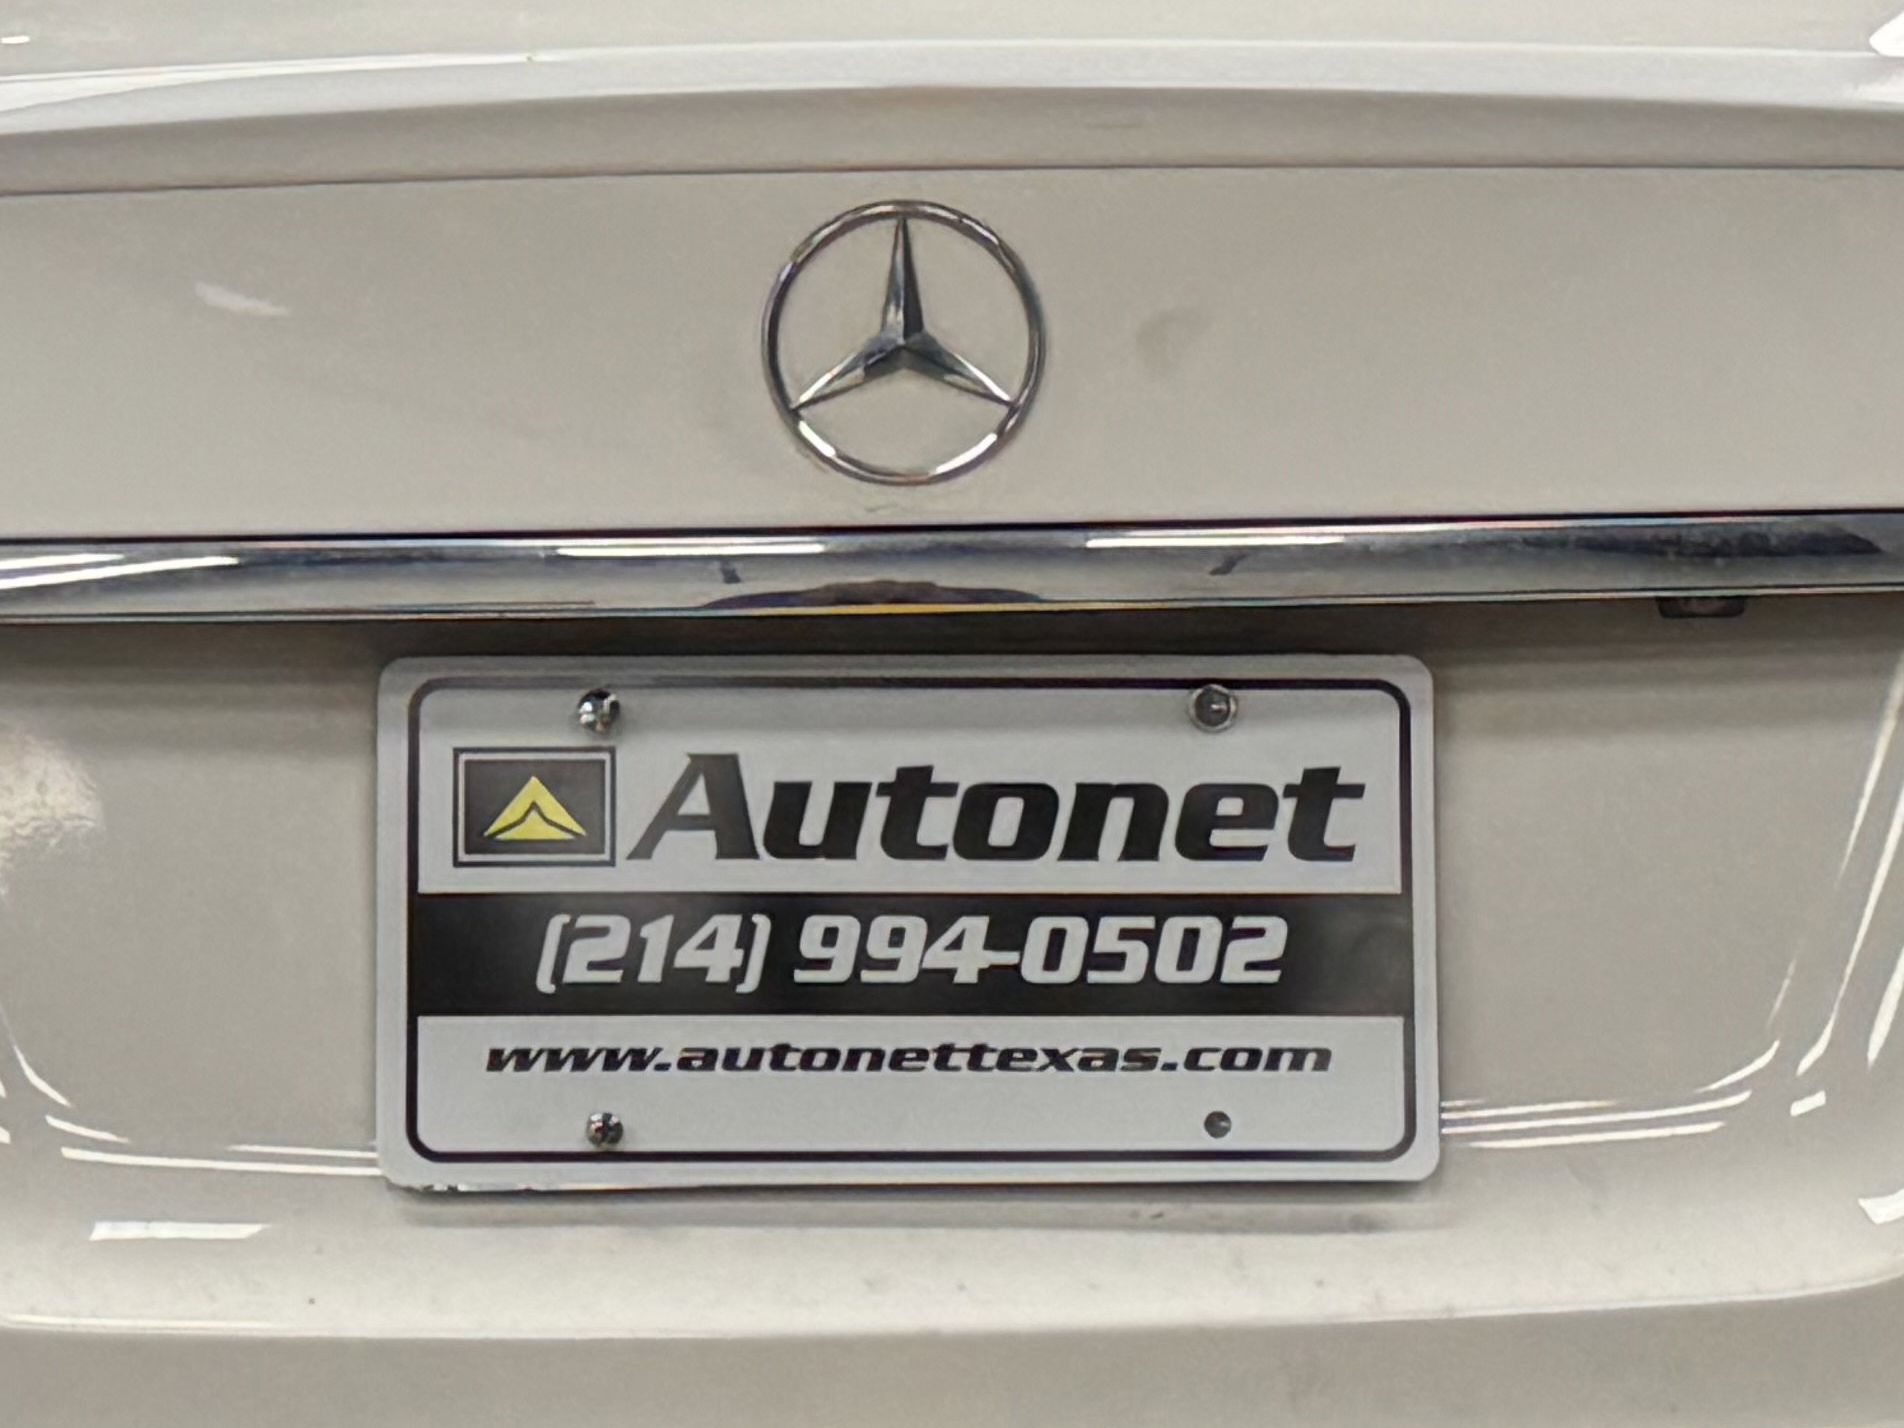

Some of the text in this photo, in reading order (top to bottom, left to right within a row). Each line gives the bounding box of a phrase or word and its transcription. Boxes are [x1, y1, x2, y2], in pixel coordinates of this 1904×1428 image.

[625, 752, 1367, 863] Autonet
[535, 912, 1289, 994] (214) 994-0502
[485, 1041, 1333, 1074] www.autonettexas.com
